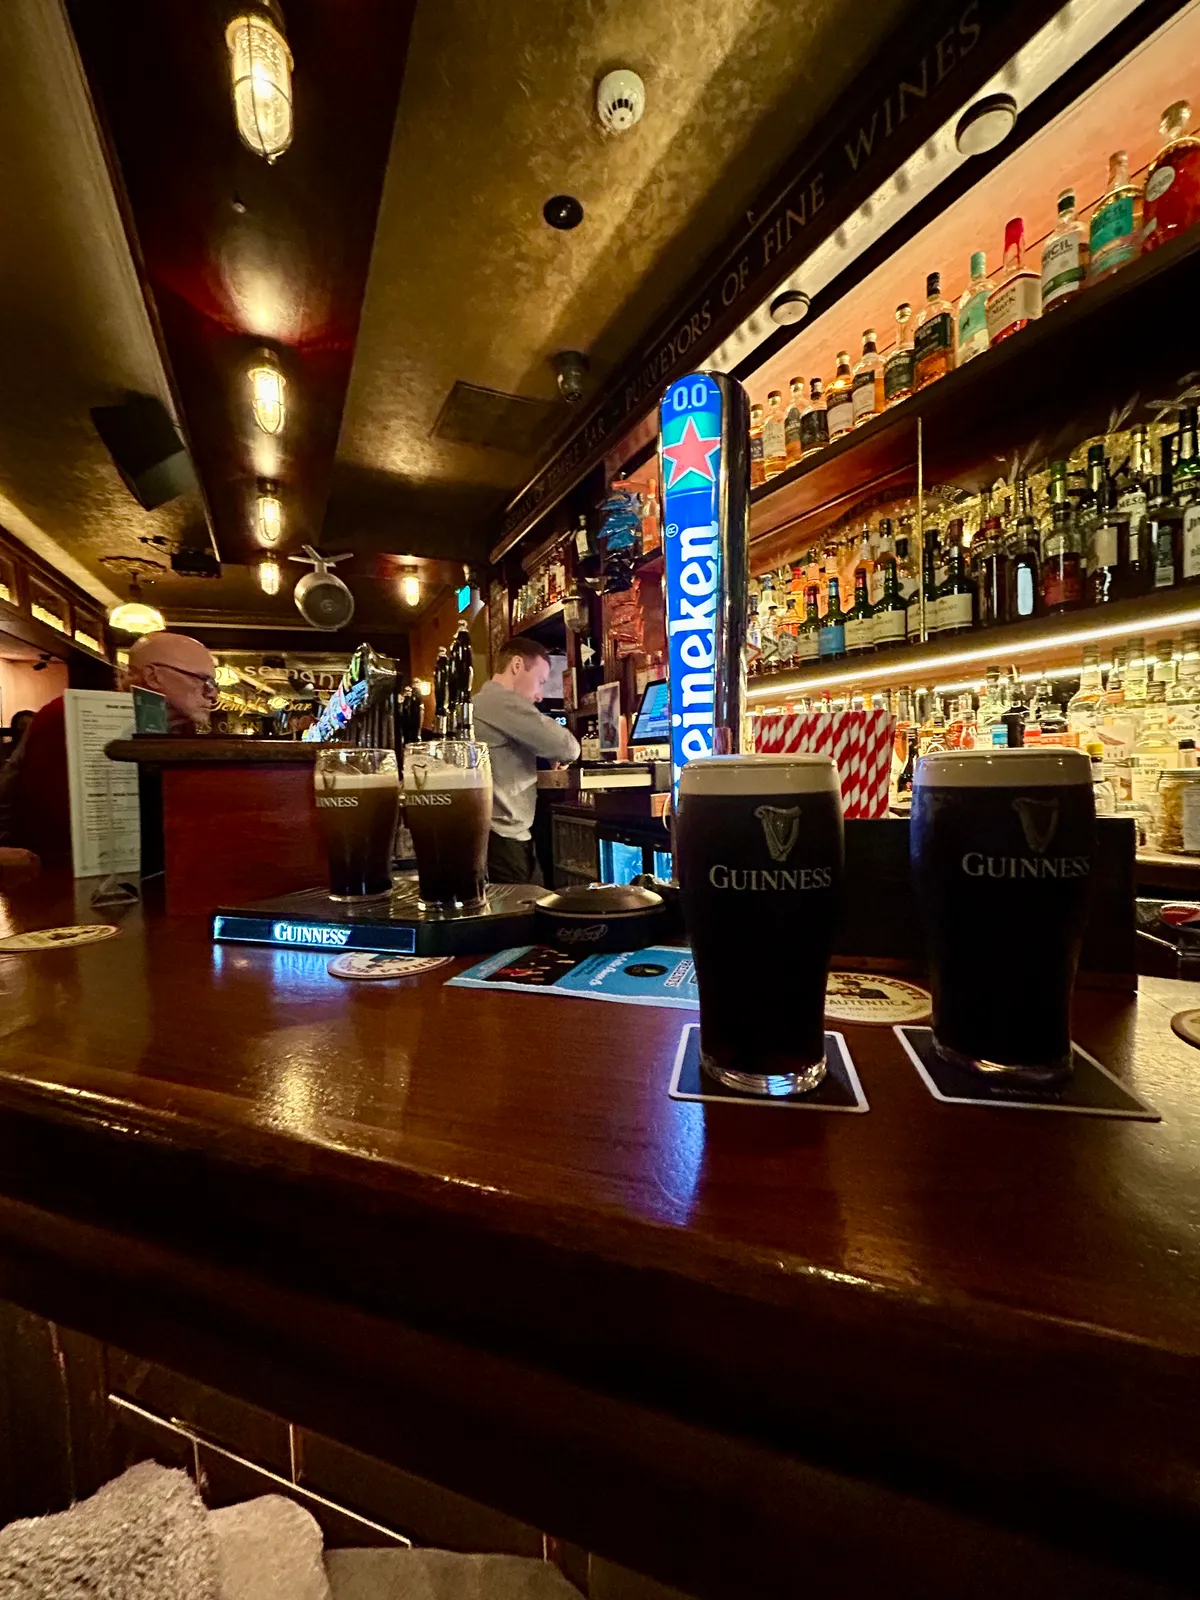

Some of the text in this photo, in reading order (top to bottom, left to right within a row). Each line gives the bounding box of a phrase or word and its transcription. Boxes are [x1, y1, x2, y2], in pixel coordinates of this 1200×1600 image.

[624, 300, 713, 412] PURVEYORS
[721, 255, 750, 307] OF
[761, 172, 825, 268] FINE
[844, 0, 982, 172] WINES
[673, 383, 708, 412] 0.0
[670, 520, 720, 810] eineken
[709, 865, 832, 891] GUINNESS
[274, 922, 347, 945] GUINNESS
